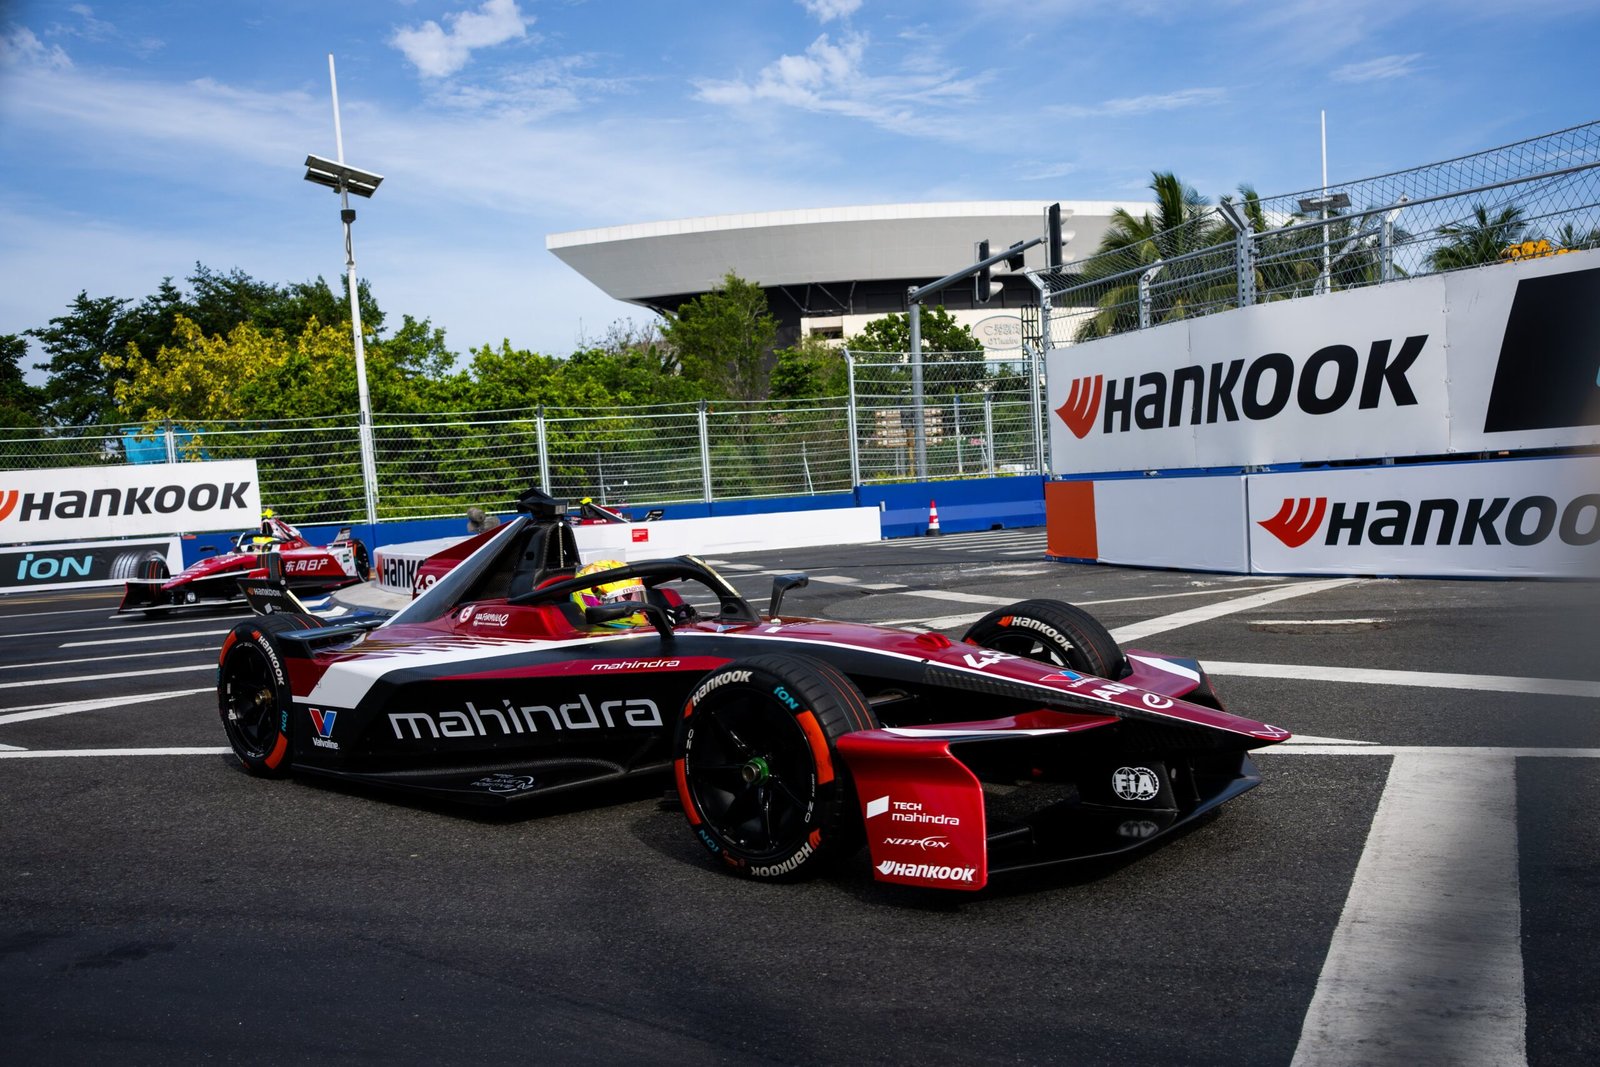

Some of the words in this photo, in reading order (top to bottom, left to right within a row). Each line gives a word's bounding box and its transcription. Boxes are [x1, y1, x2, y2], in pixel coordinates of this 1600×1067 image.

[285, 558, 328, 572] 东风日产
[591, 659, 680, 671] mahindra
[388, 694, 663, 739] mahindra
[893, 802, 922, 811] TECH
[892, 813, 959, 825] mahindra
[883, 836, 950, 851] NIPPON
